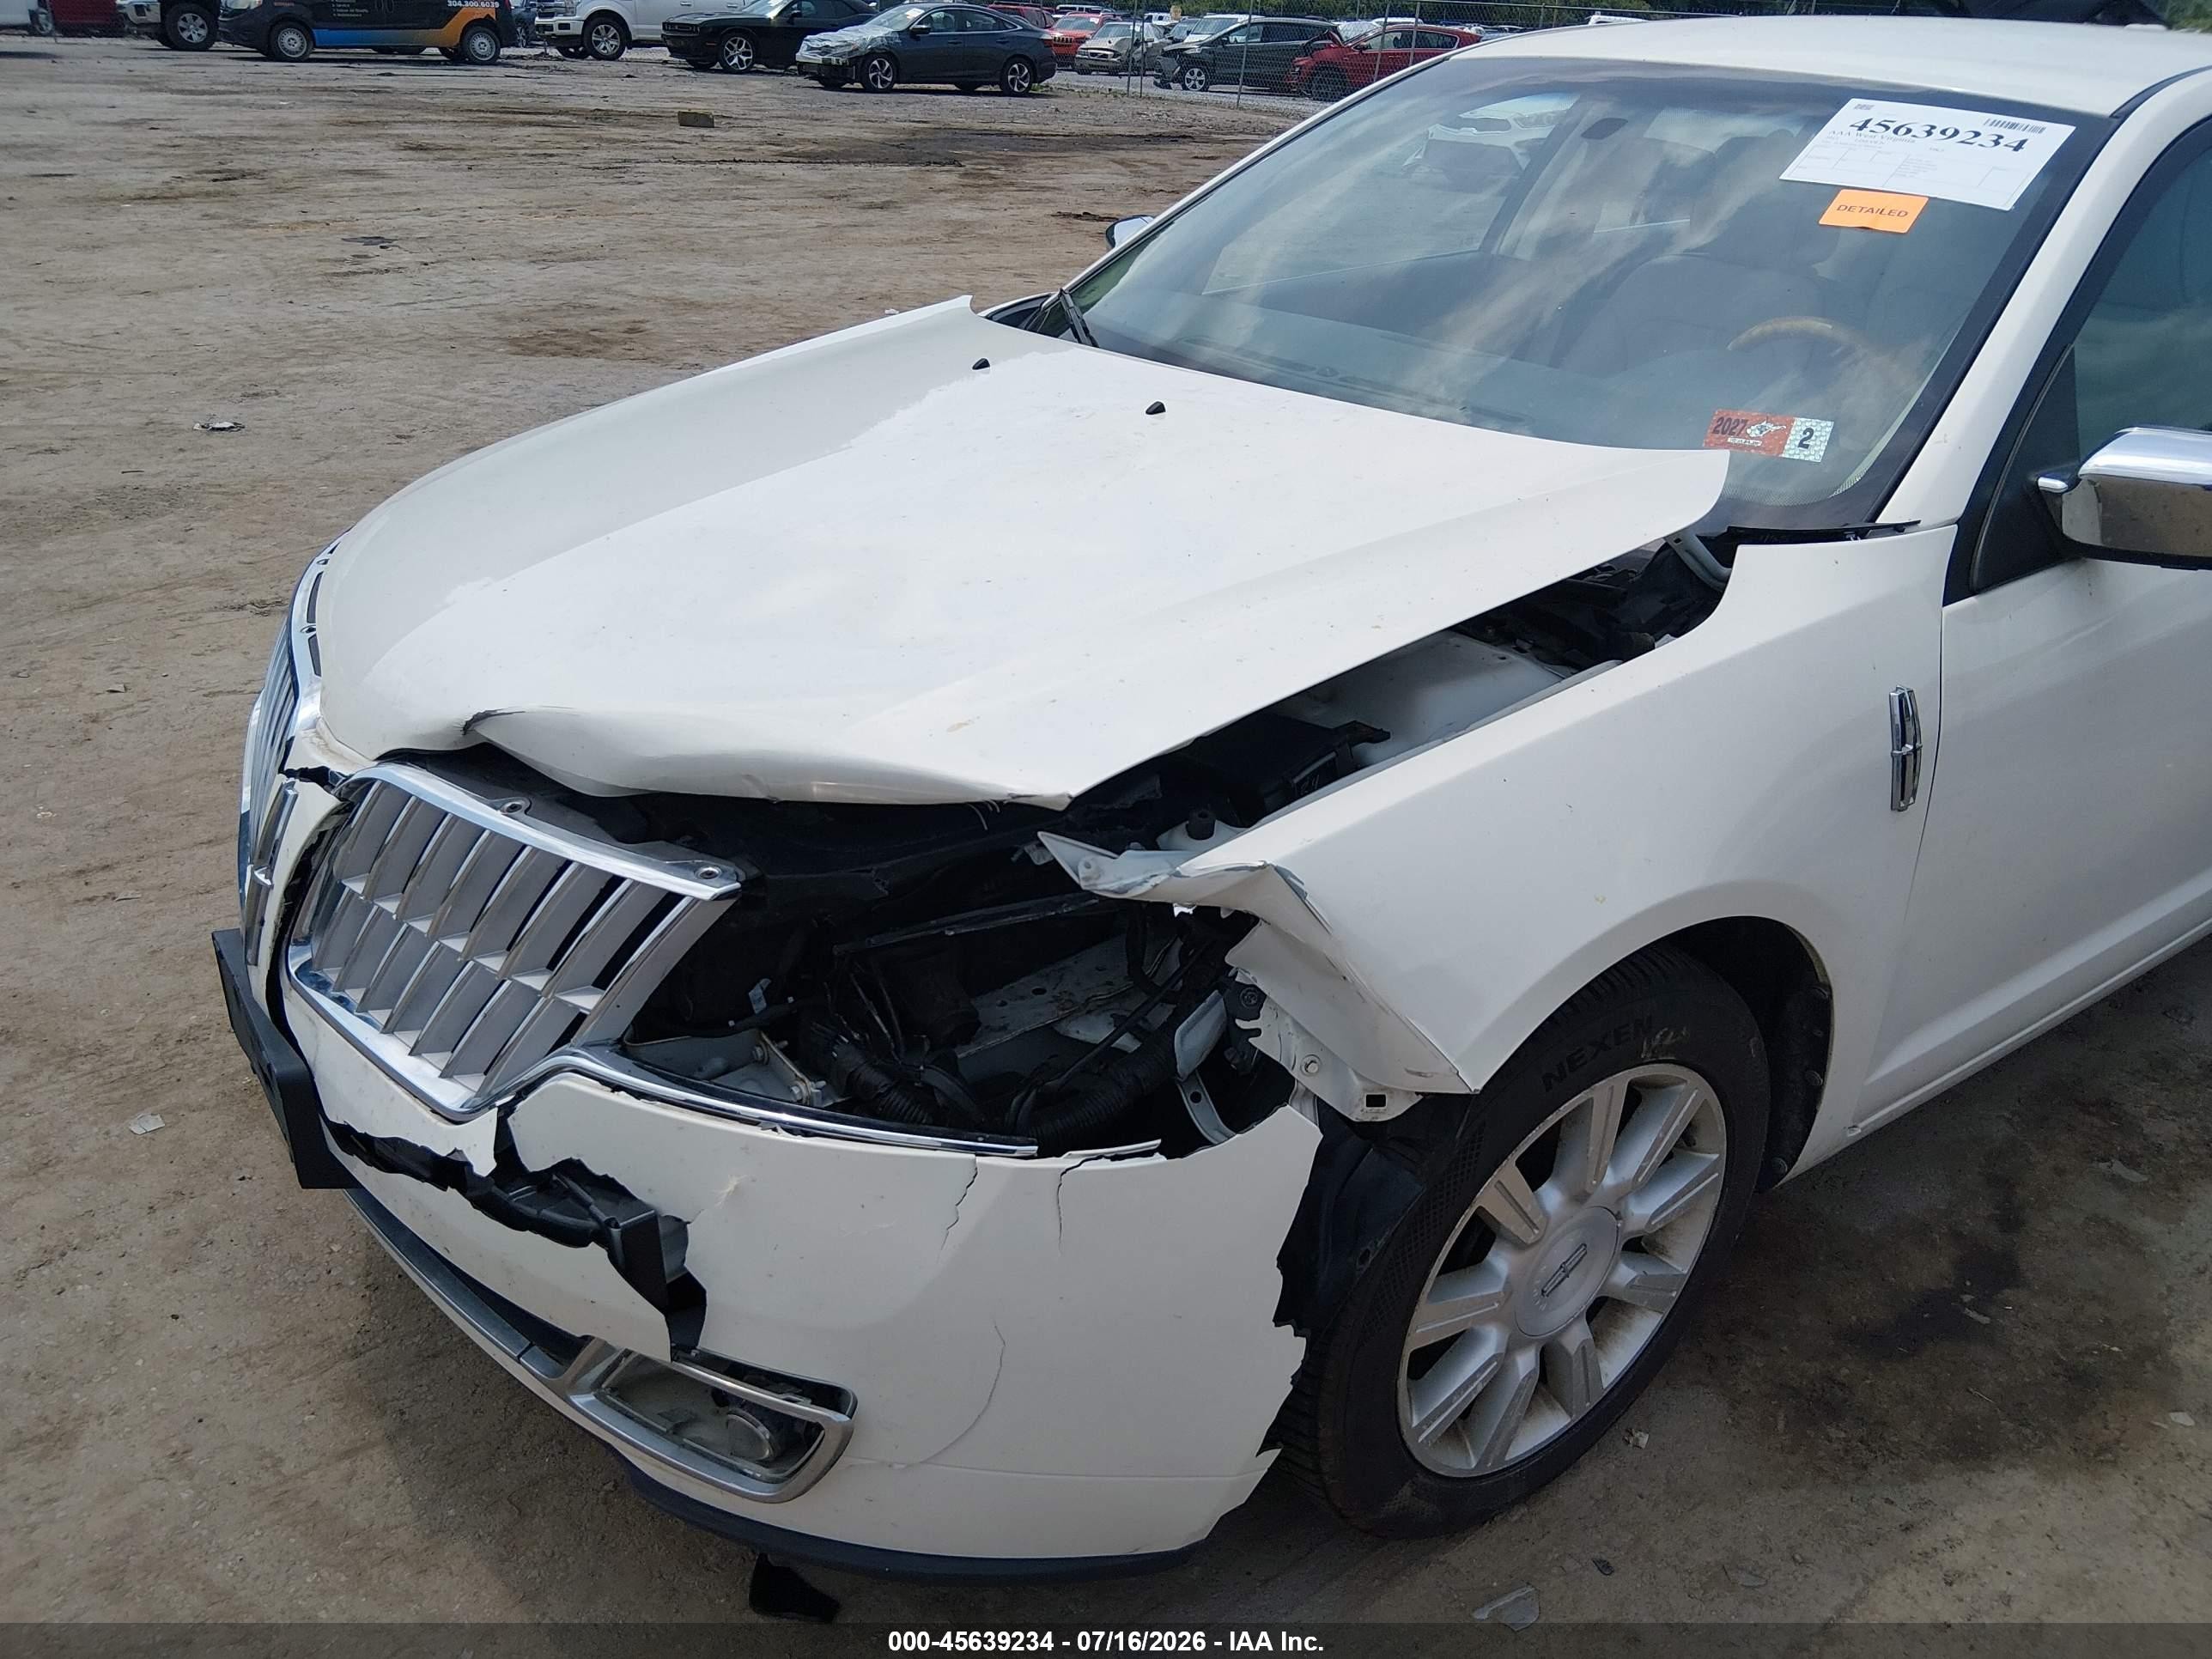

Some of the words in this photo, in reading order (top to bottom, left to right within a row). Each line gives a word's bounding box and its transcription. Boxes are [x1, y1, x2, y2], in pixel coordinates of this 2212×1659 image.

[1850, 118, 2029, 152] 45639234
[1836, 204, 1908, 218] DETAILED
[1711, 416, 1748, 436] 2027
[1797, 427, 1814, 449] 2
[1541, 1014, 1652, 1092] NEXEN
